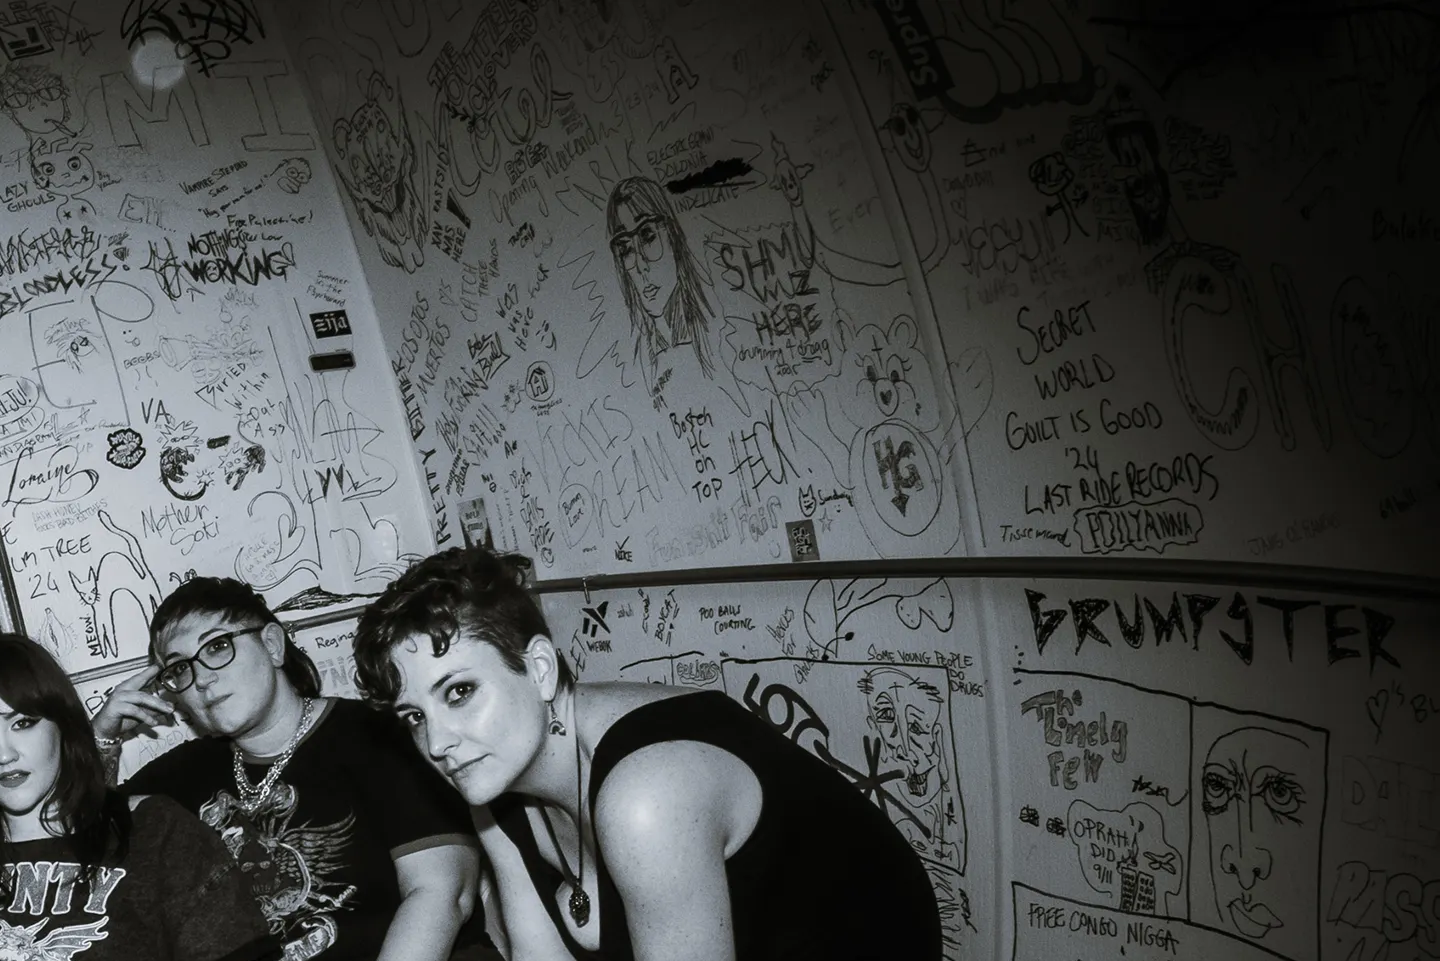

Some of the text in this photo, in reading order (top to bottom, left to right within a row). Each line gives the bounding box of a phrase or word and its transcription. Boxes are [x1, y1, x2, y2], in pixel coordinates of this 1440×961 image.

[7, 193, 58, 213] GHOULS
[1035, 354, 1115, 400] WORLD
[1006, 398, 1163, 451] GUILT IS GOOD
[692, 478, 723, 503] TOP
[1024, 484, 1071, 515] LAST
[1125, 452, 1220, 501] RECORDS
[142, 502, 209, 539] Mother
[44, 534, 92, 561] TREE
[1024, 588, 1401, 677] GRUMPSTER
[867, 643, 974, 669] SOME YOUNG PEOPLE
[950, 679, 985, 698] DRUGS
[1073, 821, 1129, 848] OPRAH
[1090, 842, 1116, 862] DID
[1092, 864, 1113, 886] 9/11
[1027, 903, 1180, 955] FREE CONGO NIGGA
